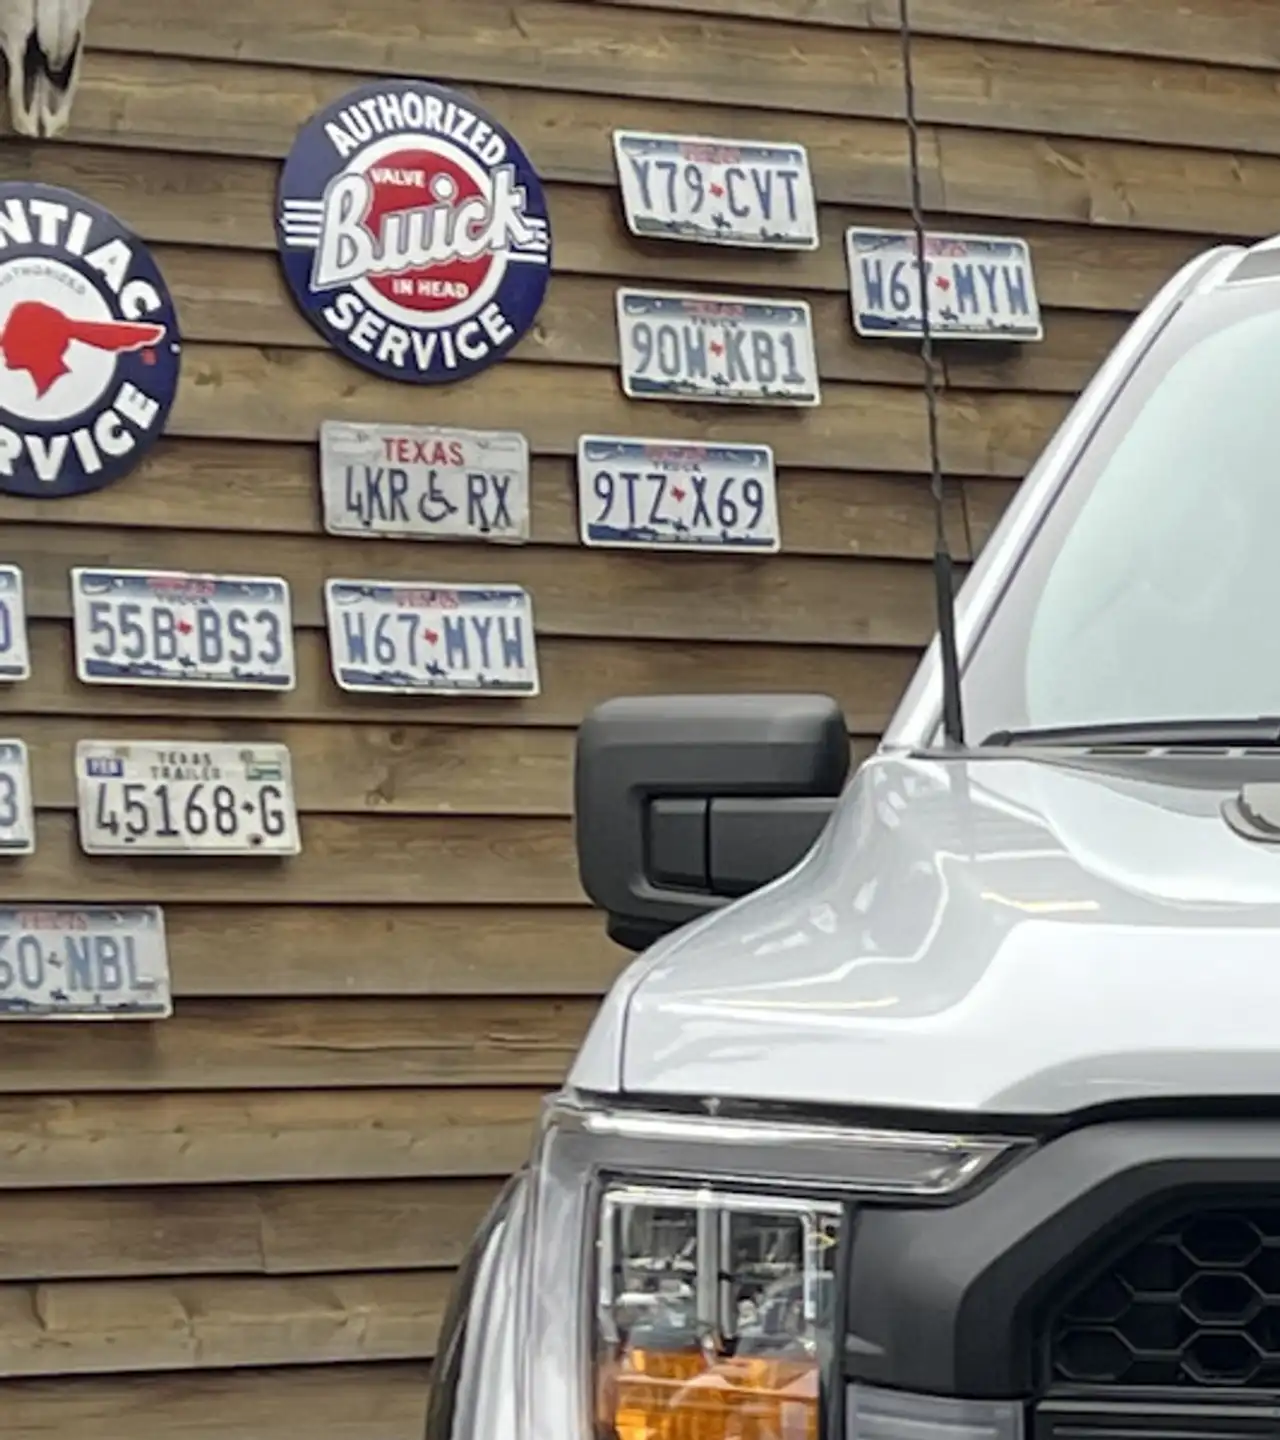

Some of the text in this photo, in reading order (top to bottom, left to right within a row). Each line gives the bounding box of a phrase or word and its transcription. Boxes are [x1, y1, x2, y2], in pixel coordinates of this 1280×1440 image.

[324, 91, 507, 167] AUTHORIZED
[370, 167, 426, 188] VALVE
[631, 157, 799, 222] Y79 CVT
[310, 163, 537, 292] Buick
[393, 278, 470, 300] IN HEAD
[324, 293, 514, 370] SERVICE
[381, 437, 465, 467] TEXAS
[346, 465, 513, 529] 4KR RX
[594, 470, 764, 530] 9TZ X69
[89, 600, 283, 665] 55B BS3
[342, 611, 420, 667] W67
[97, 782, 285, 837] 45168 G
[65, 935, 157, 993] NBL
